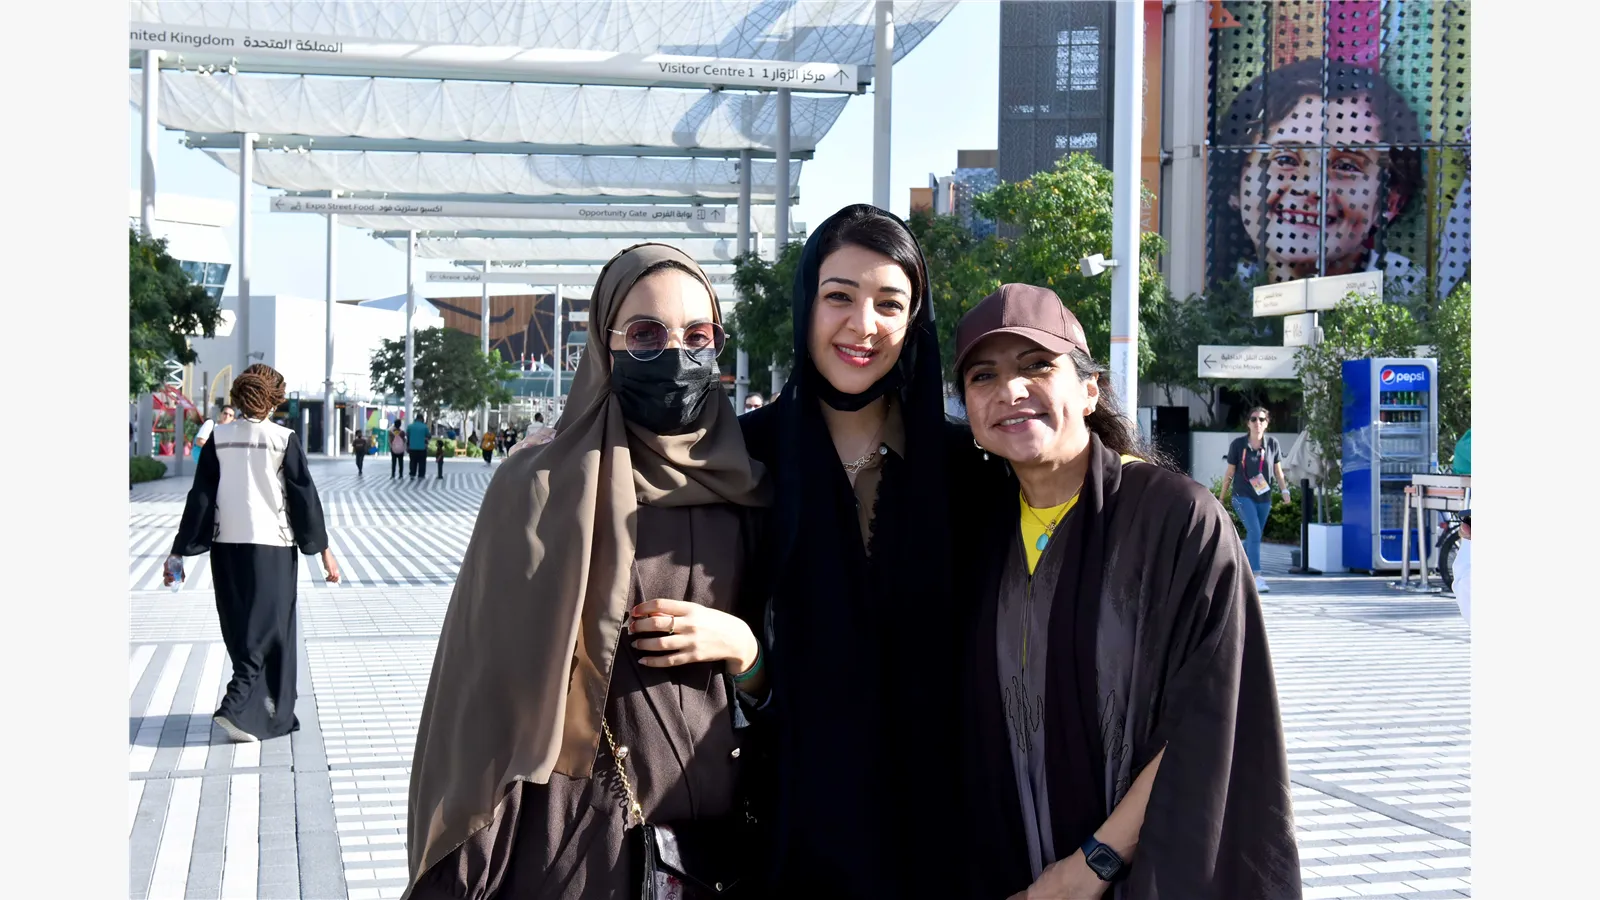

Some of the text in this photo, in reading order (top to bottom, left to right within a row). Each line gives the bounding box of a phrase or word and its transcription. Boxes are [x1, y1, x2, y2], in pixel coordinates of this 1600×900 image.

[130, 29, 235, 47] nited Kingdom
[243, 36, 343, 53] المملكة المتحدة
[658, 62, 754, 77] Visitor Centre 1
[762, 68, 769, 78] 1
[801, 69, 826, 83] مركز
[305, 202, 326, 210] Expo
[353, 203, 375, 211] Food
[578, 209, 648, 218] Opportunity Gate
[652, 210, 693, 219] بوابة الفرص
[1396, 370, 1425, 383] pepsi
